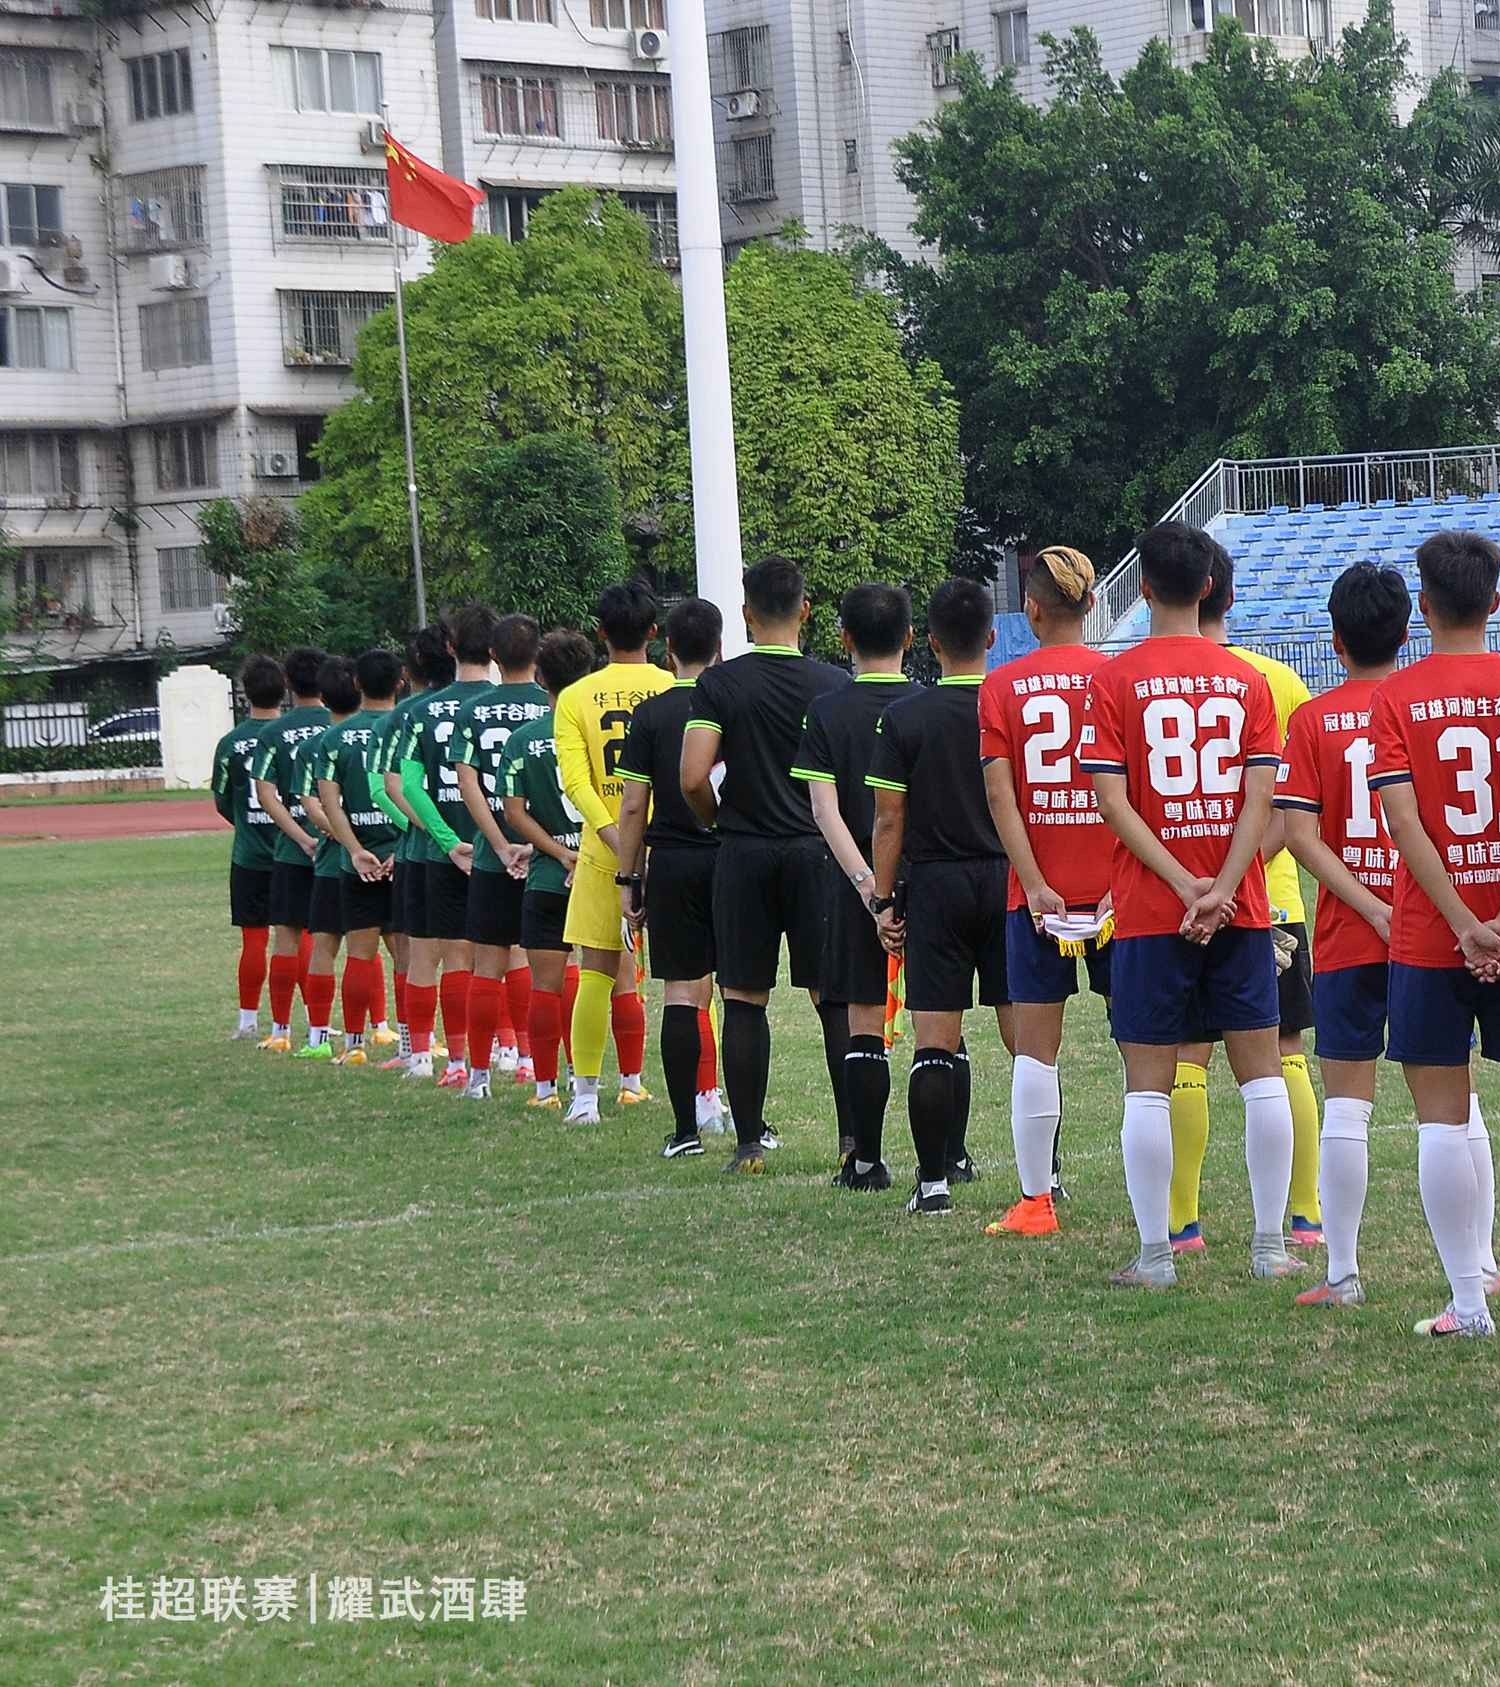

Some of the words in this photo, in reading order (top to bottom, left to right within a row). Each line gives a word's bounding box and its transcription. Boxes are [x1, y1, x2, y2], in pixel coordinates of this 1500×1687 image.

[1134, 674, 1249, 699] 冠雄河池生态餐厅
[1143, 696, 1247, 796] 82
